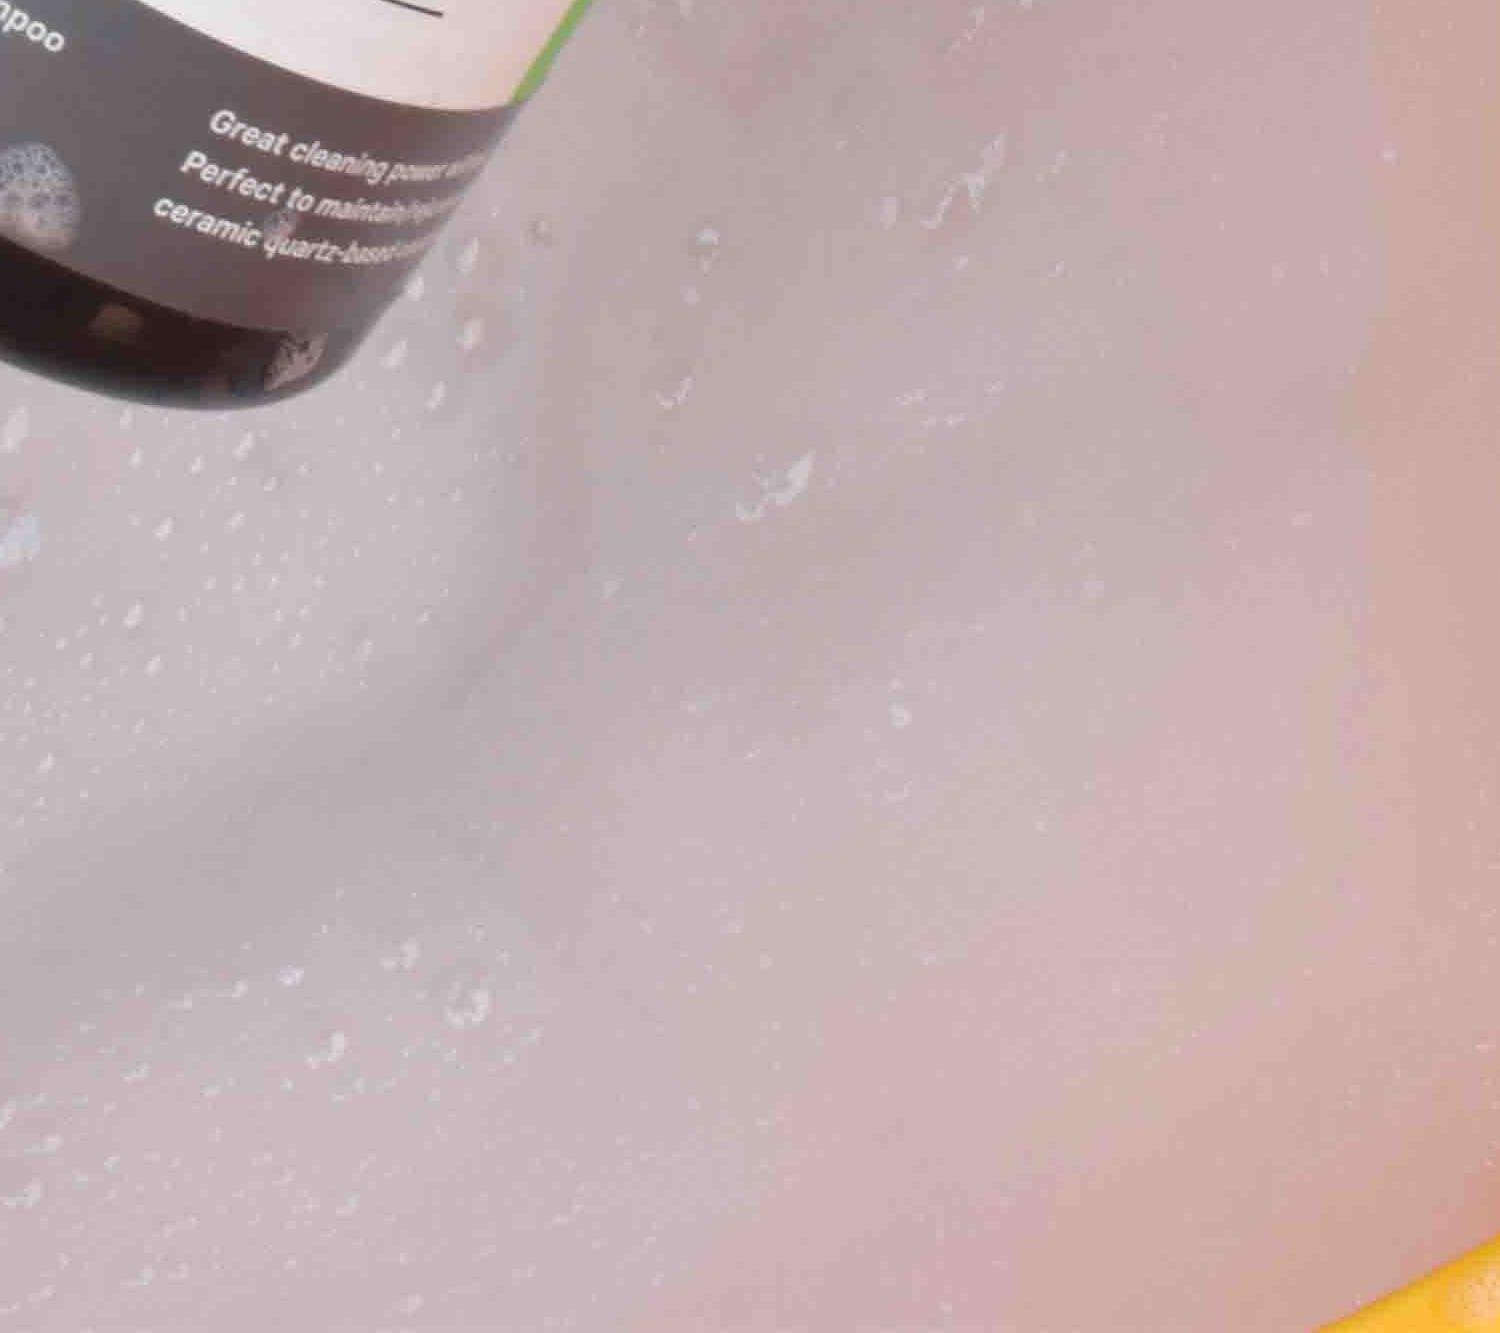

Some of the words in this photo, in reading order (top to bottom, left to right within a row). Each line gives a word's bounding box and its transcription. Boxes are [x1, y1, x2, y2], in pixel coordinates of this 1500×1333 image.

[209, 109, 290, 156] Great
[289, 140, 389, 185] cleaning
[179, 149, 286, 205] Perfect
[286, 186, 315, 212] to
[153, 197, 262, 247] ceramic
